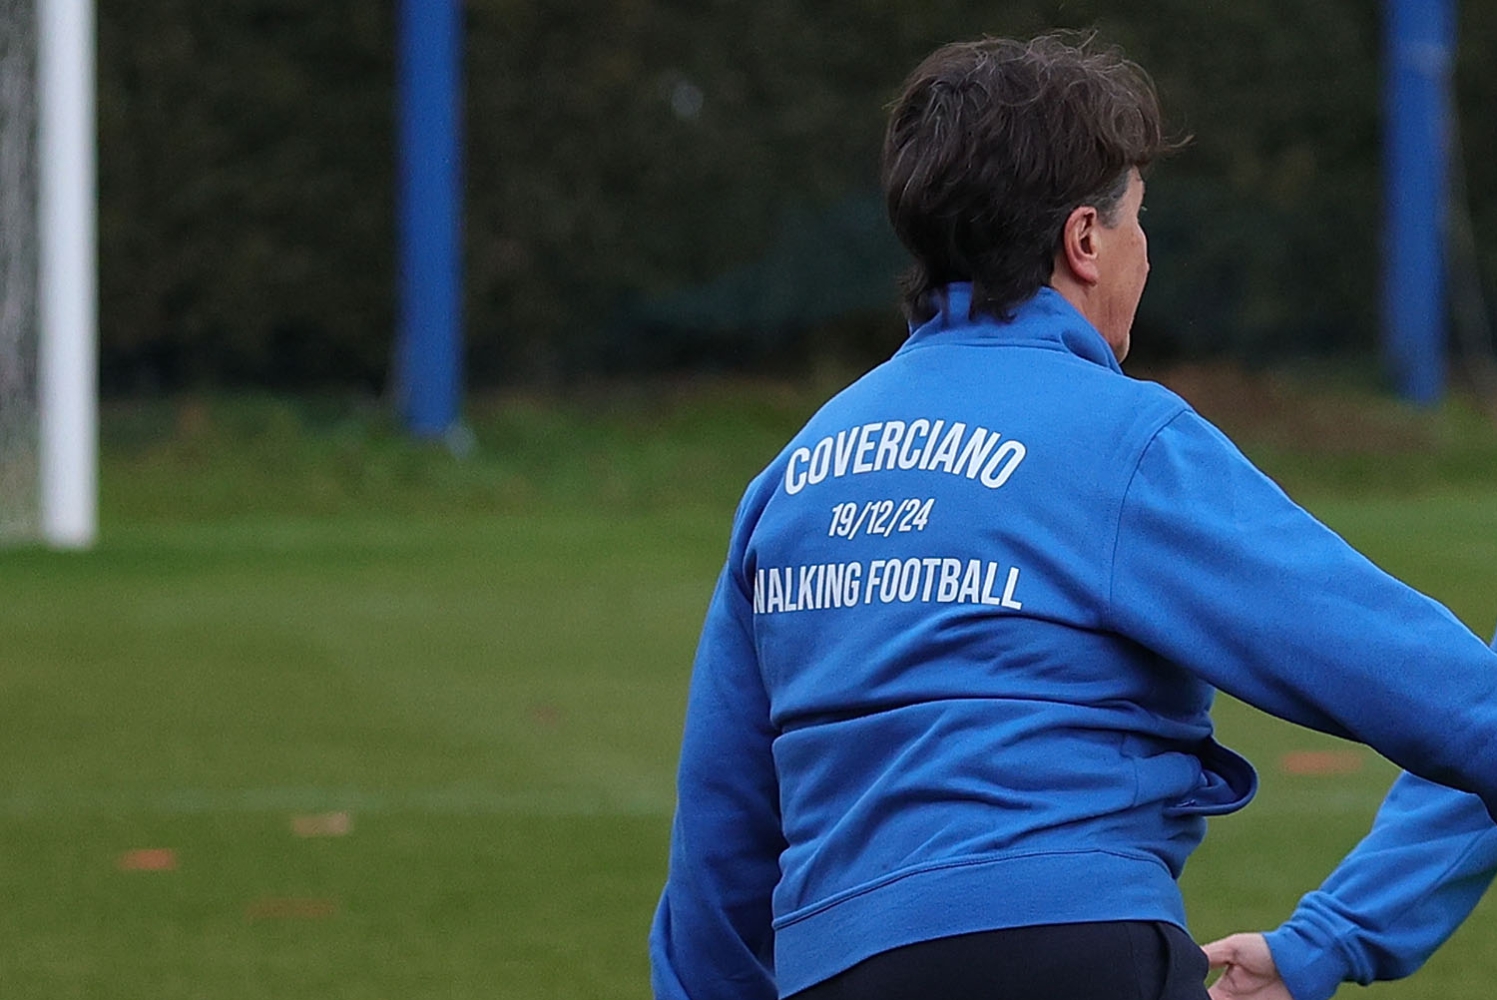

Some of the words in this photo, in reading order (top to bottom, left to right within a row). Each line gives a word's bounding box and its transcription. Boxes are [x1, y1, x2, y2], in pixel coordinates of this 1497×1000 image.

[784, 418, 1027, 495] COVERCIANO
[828, 498, 934, 540] 19/12/24
[864, 557, 1023, 610] FOOTBALL
